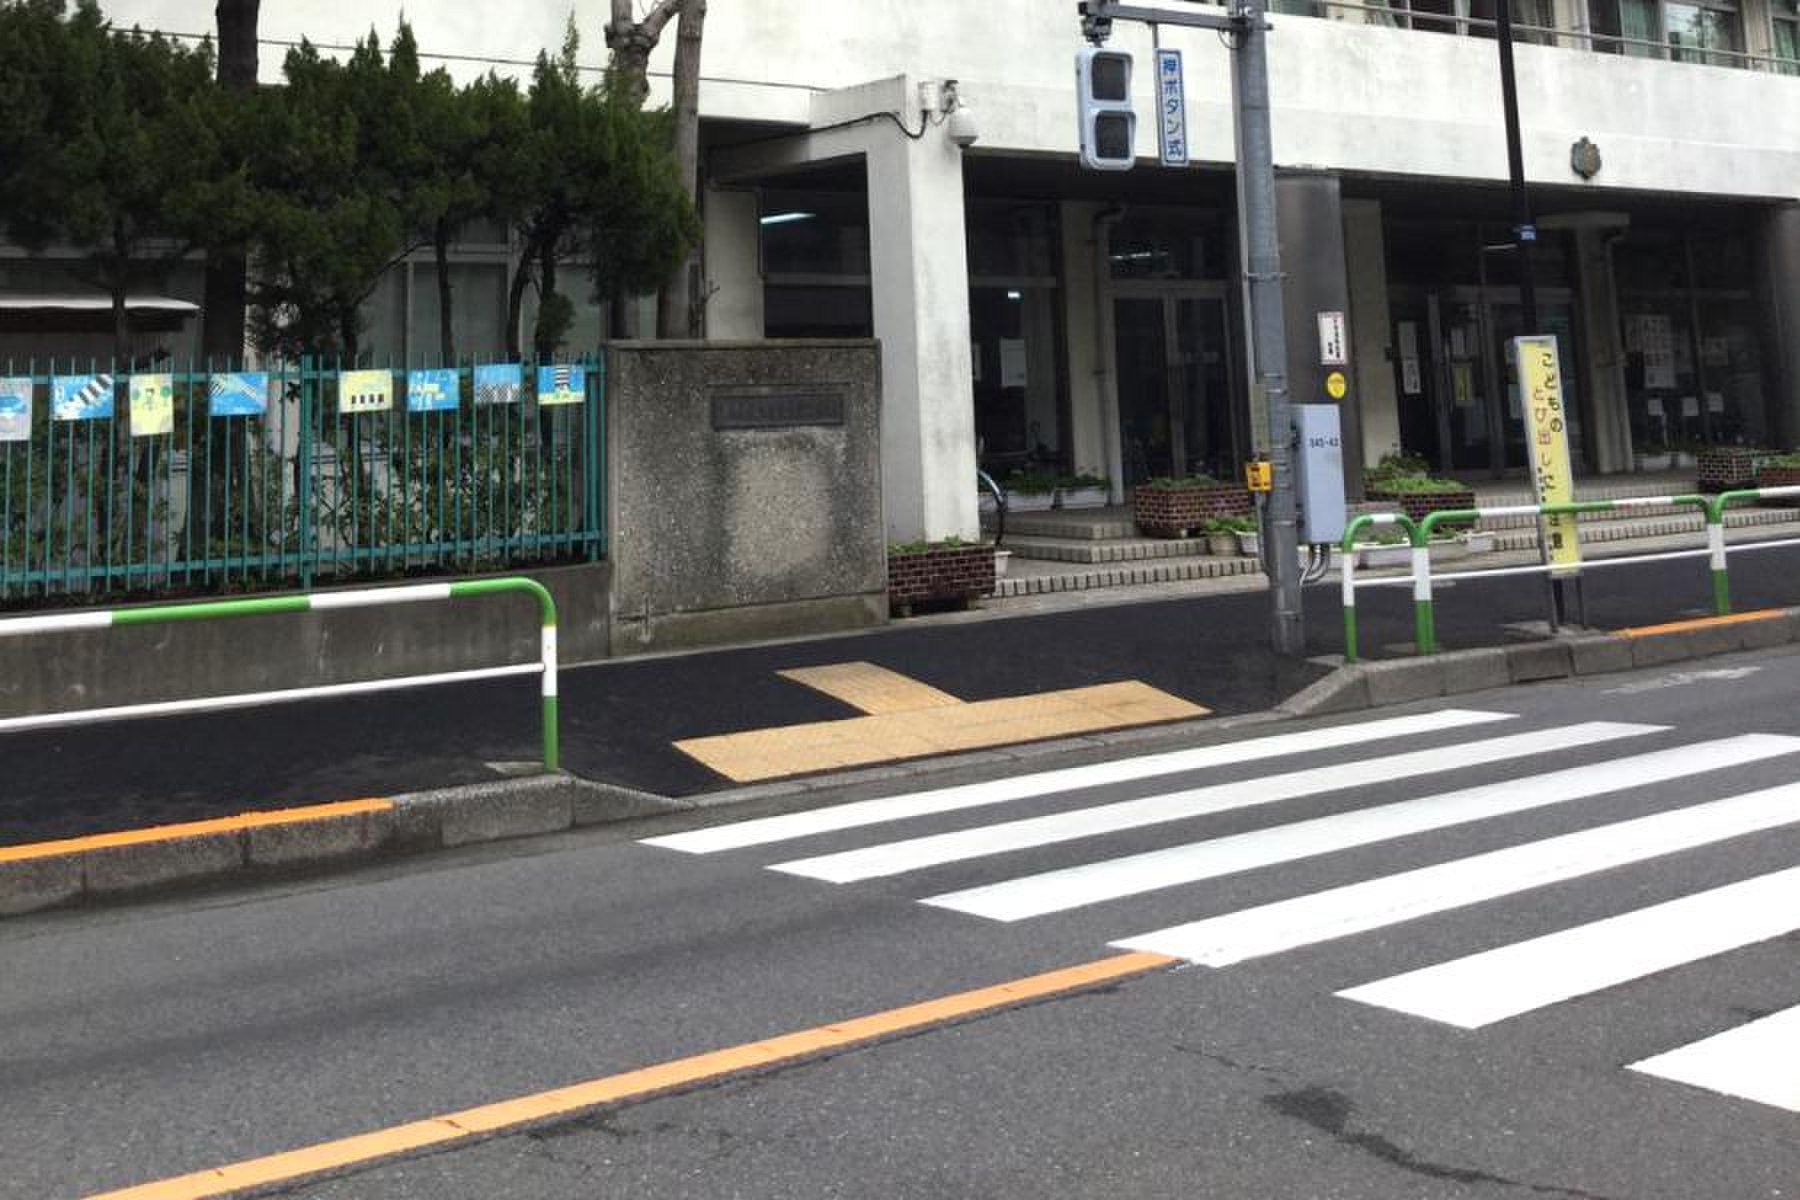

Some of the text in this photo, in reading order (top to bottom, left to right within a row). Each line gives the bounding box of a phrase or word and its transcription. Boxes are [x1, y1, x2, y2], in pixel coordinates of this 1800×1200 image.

[1162, 58, 1183, 158] 押ボタン式
